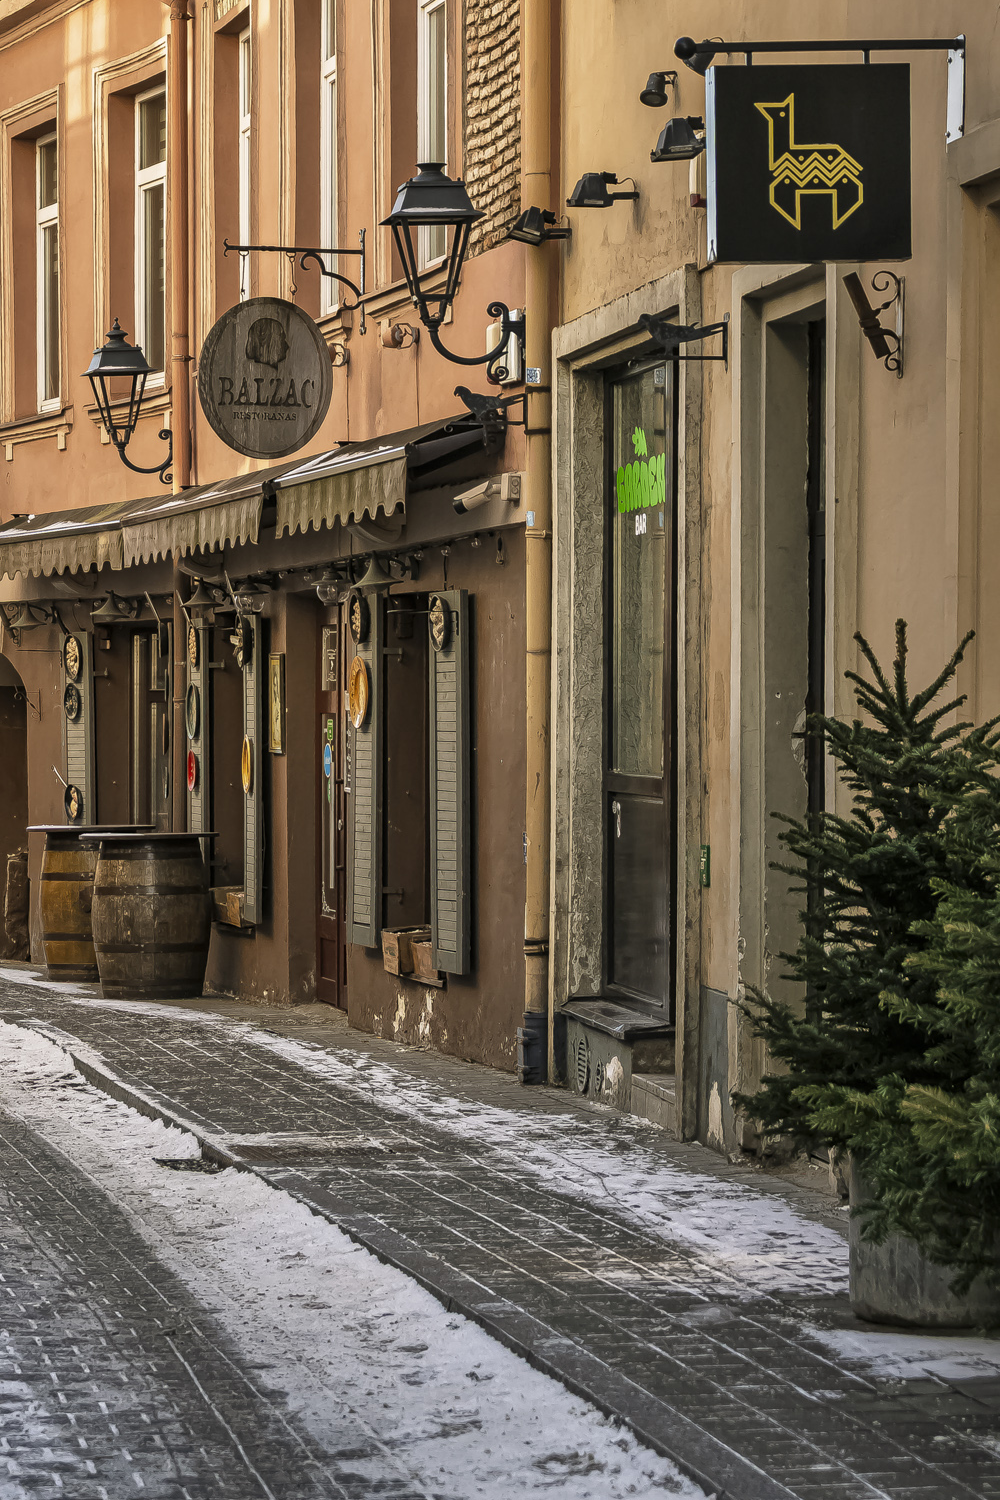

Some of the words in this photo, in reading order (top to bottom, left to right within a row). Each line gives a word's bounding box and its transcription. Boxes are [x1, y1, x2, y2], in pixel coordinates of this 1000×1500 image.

[218, 376, 315, 408] BALZAC
[233, 411, 297, 421] RESTORANAS
[616, 452, 666, 513] GARDEN
[635, 513, 647, 536] BAR
